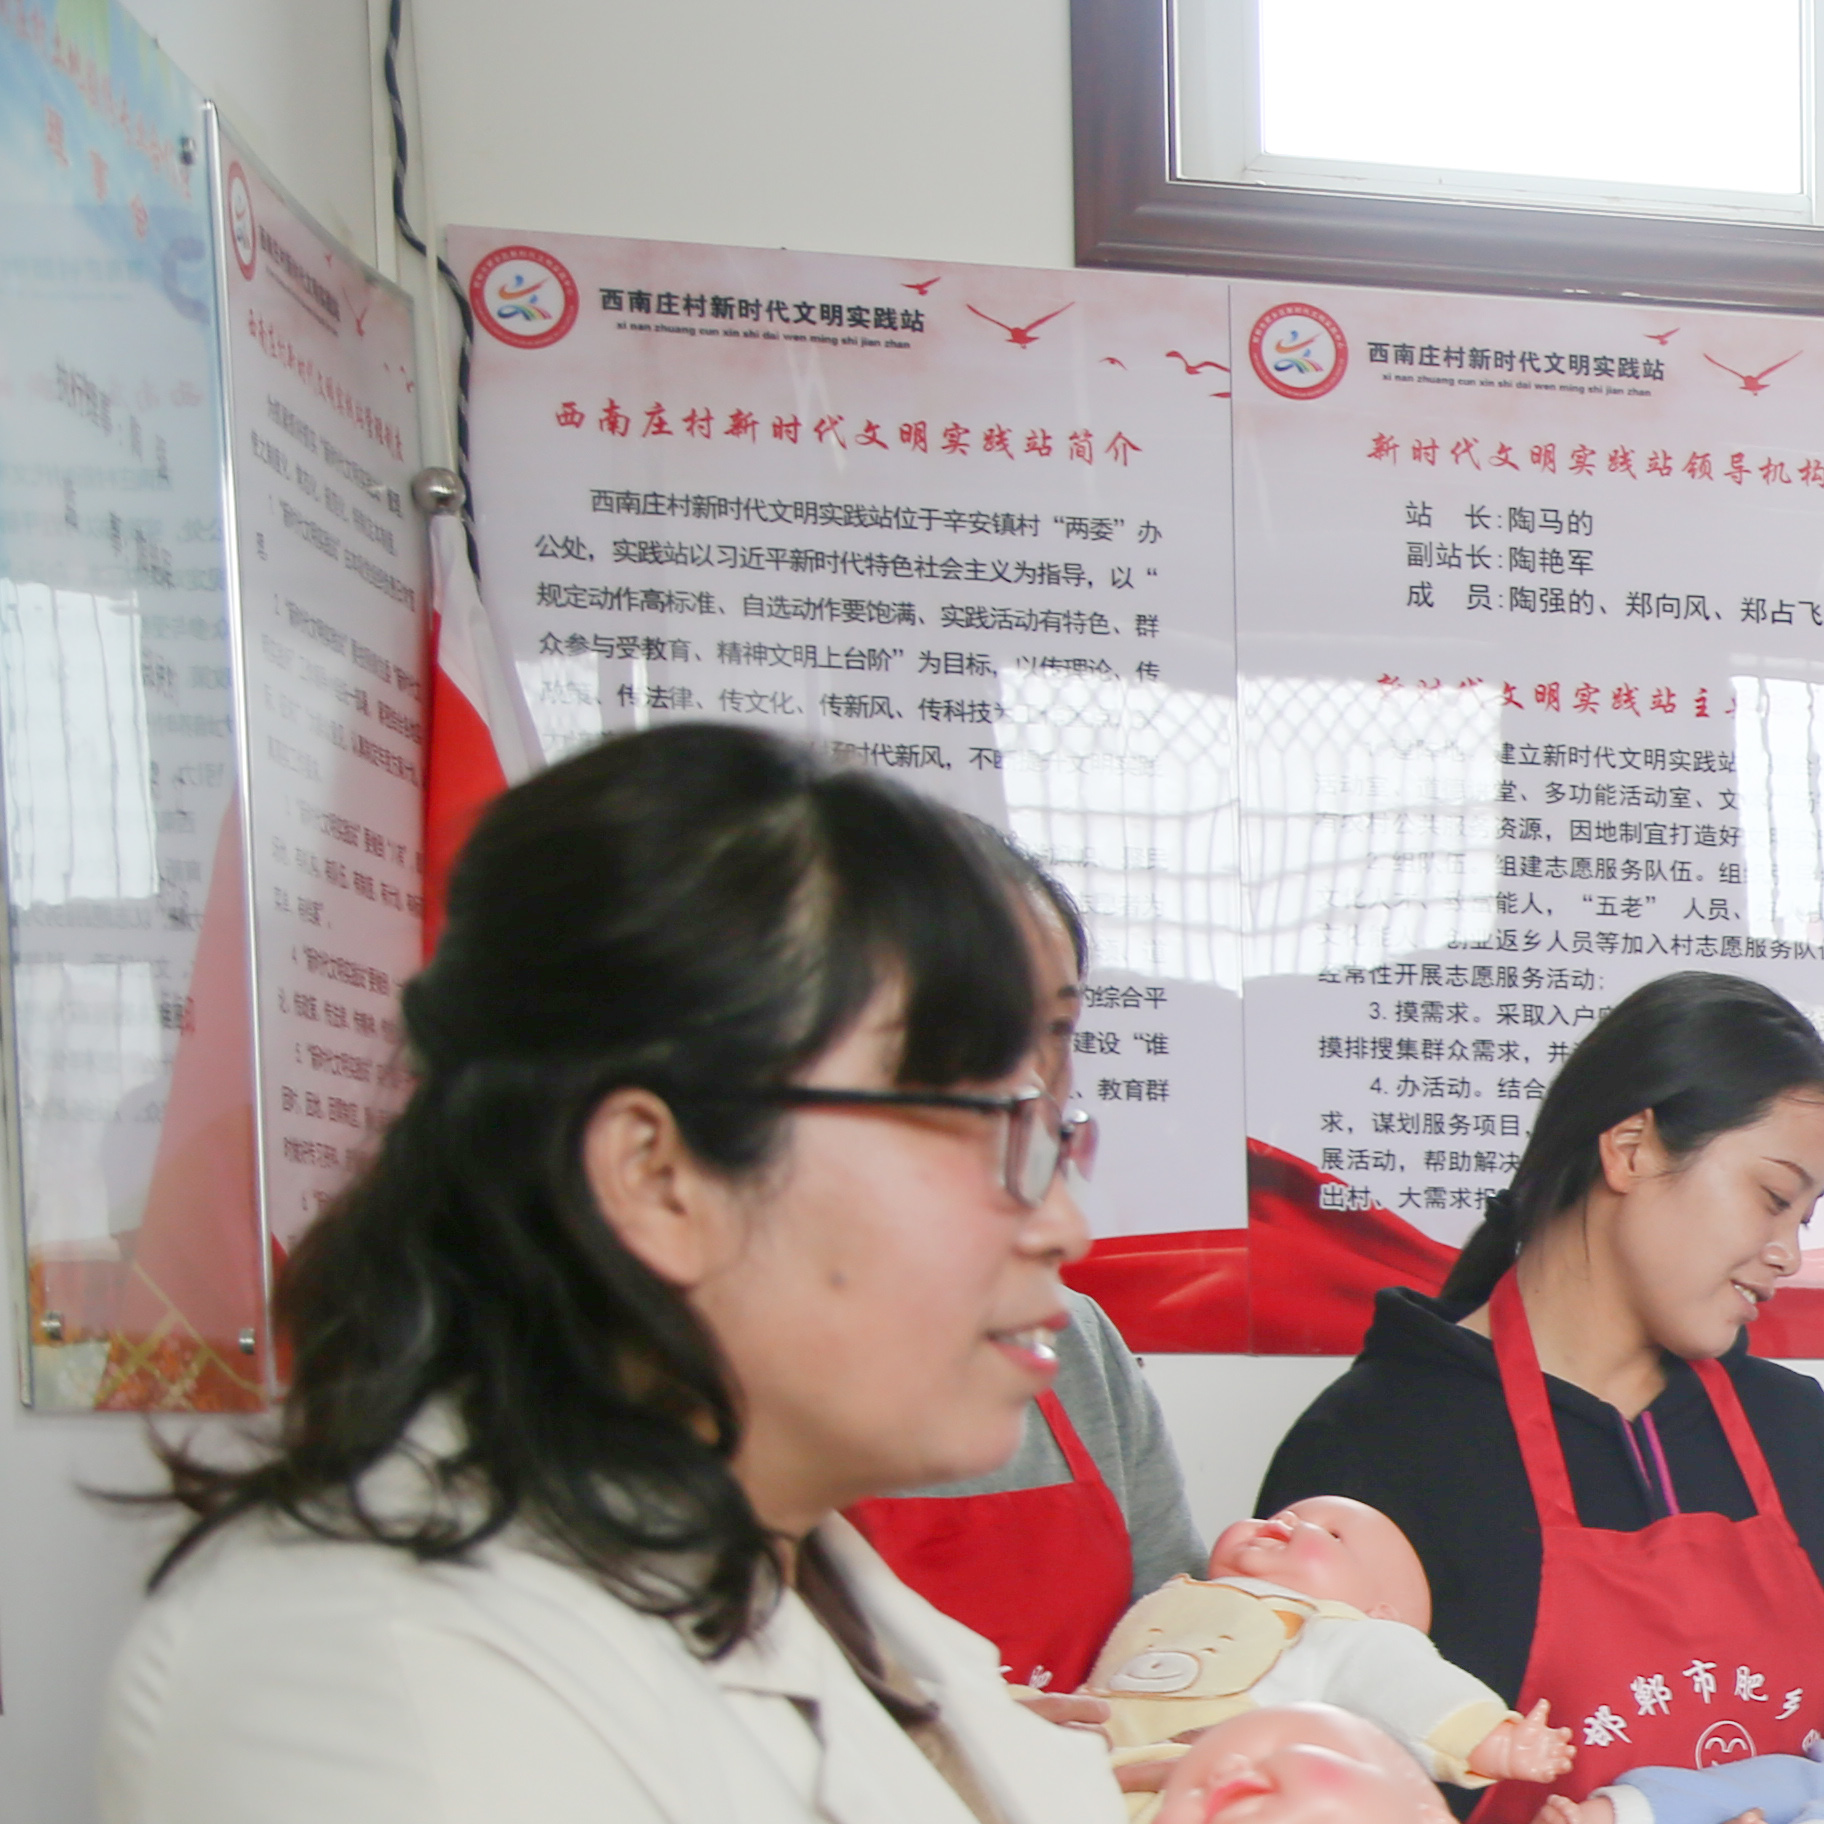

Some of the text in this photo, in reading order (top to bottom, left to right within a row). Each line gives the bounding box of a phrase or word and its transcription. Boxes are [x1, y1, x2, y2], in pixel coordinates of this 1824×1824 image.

[598, 286, 926, 334] 西南庄村新时代文明实践站
[616, 322, 911, 350] xi nan zhuang cun xin shi dai wen ming shi jian zhan
[1367, 341, 1665, 382] 西南庄村新时代文明实践站
[1382, 373, 1651, 397] xi nan zhuang cun xin shi dai wen ming shi jian zhan
[555, 398, 1142, 467] 西南庄村新时代文明实践站简介
[1406, 501, 1433, 529] 站
[1406, 582, 1434, 609] 成
